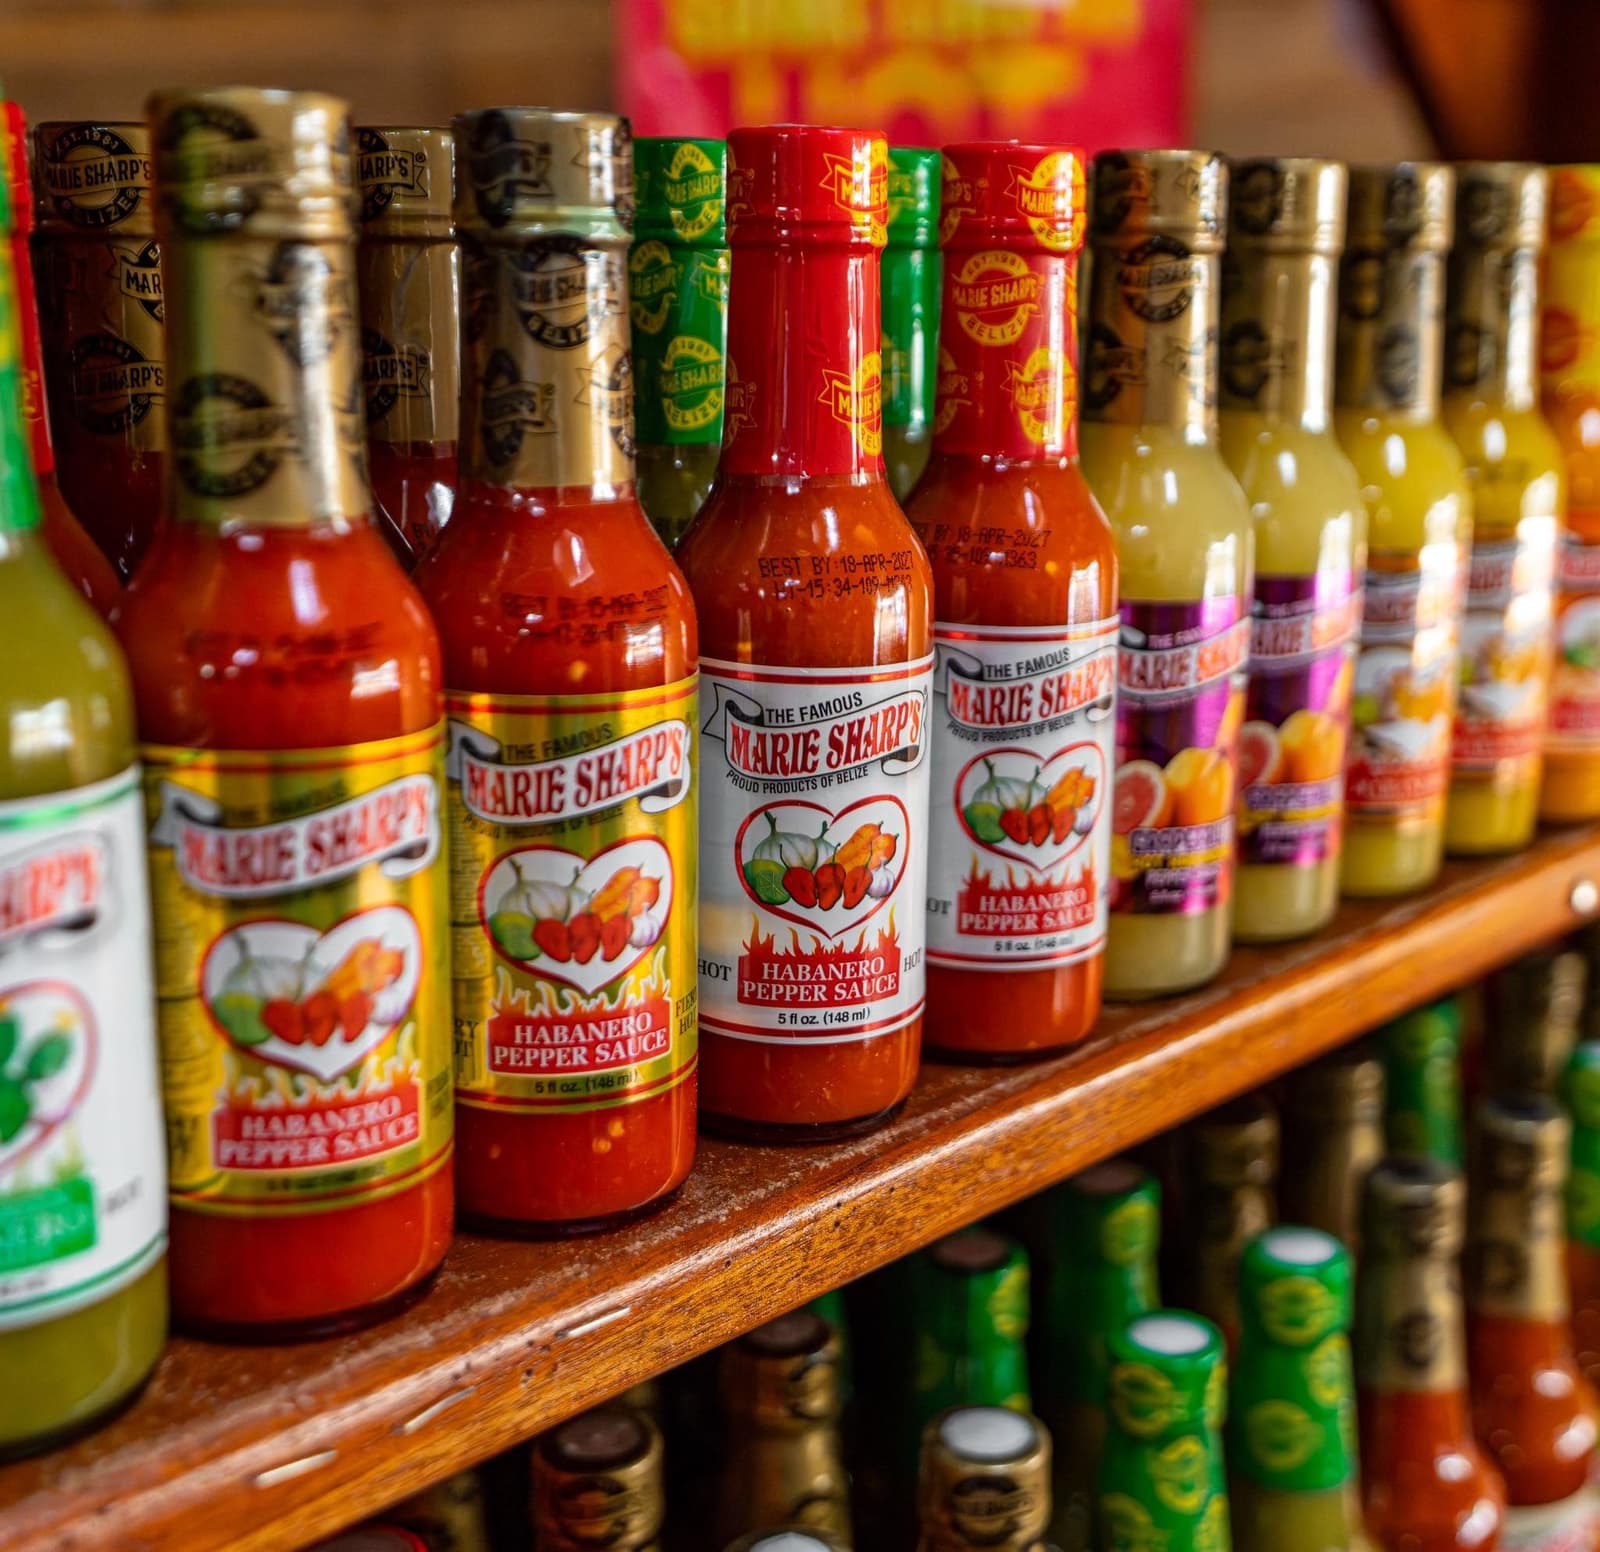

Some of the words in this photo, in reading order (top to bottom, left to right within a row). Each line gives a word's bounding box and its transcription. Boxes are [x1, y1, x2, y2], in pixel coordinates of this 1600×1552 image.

[84, 159, 152, 187] SHARP'S
[361, 155, 408, 180] ARP'S
[126, 269, 161, 294] MAR
[758, 557, 801, 578] BEST
[984, 663, 1012, 679] THE
[1016, 648, 1070, 676] FAMOUS
[765, 708, 795, 724] THE
[800, 691, 863, 721] FAMOUS
[951, 678, 1033, 726] MARIE
[507, 743, 534, 761] THE
[542, 722, 613, 757] FAMOUS
[730, 721, 820, 777] MARIE
[826, 698, 922, 770] SHARP'S
[466, 761, 567, 818] MARIE
[573, 727, 684, 808] SHARP'S
[725, 769, 760, 793] PROUD
[763, 777, 818, 795] PRODUCTS
[820, 775, 834, 790] OF
[836, 766, 869, 785] BELIZE
[927, 897, 951, 914] OT
[980, 887, 1087, 913] HABANERO
[960, 913, 1039, 931] PEPPER
[698, 958, 732, 982] HOT
[762, 956, 886, 983] HABANERO
[742, 981, 827, 1002] PEPPER
[833, 972, 897, 1001] SAUCE
[514, 1012, 652, 1044] HABANERO
[777, 1012, 786, 1025] 5
[789, 1011, 797, 1025] fl
[800, 1014, 819, 1025] oz.
[823, 1010, 849, 1025] (148
[851, 1007, 871, 1022] ml)
[493, 1046, 588, 1068] PEPPER
[595, 1028, 667, 1063] SAUCE
[535, 1081, 543, 1093] 5
[241, 1095, 401, 1138] HABANERO
[219, 1138, 328, 1165] PEPPER
[334, 1112, 417, 1156] SAUCE
